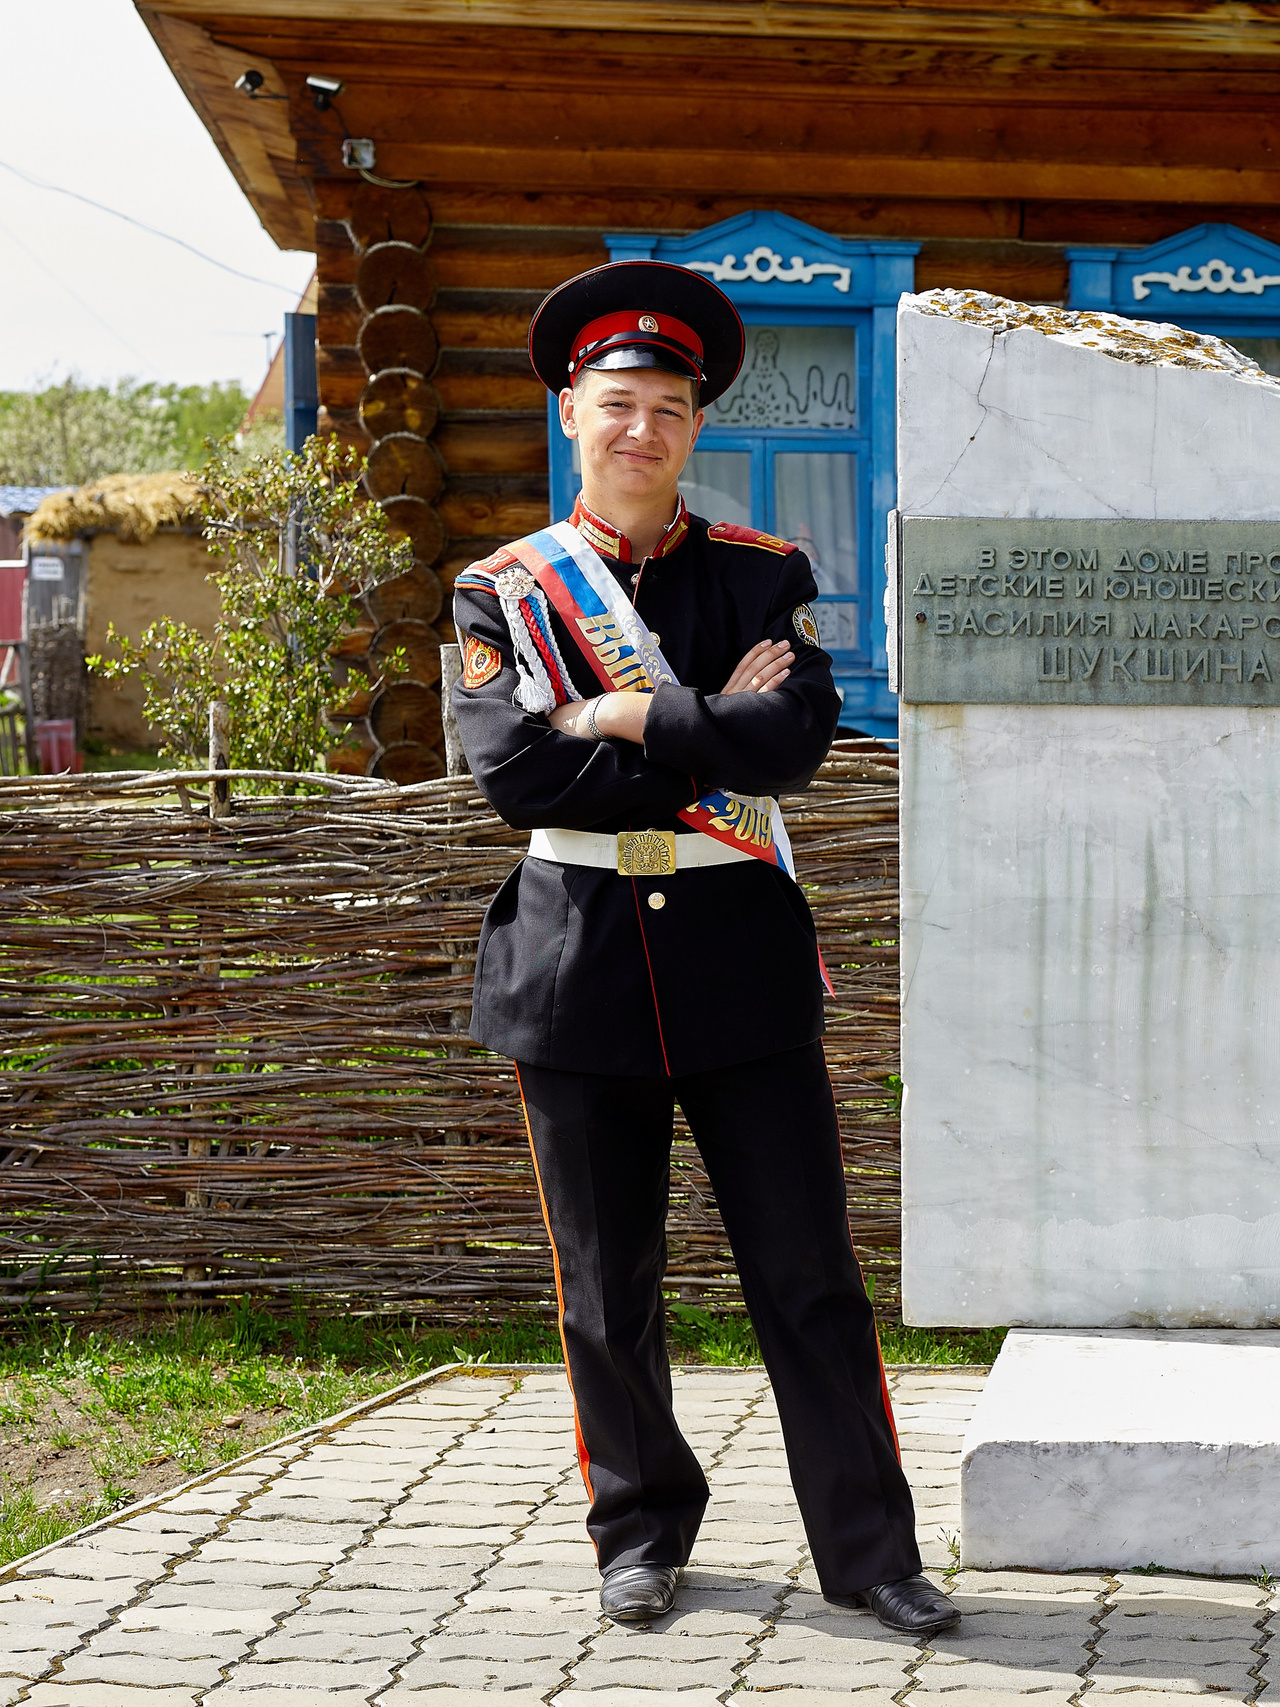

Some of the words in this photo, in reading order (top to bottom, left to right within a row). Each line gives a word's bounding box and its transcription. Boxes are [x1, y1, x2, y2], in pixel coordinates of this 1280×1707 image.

[976, 547, 997, 570] В
[1008, 546, 1099, 571] ЭТОМ
[1112, 549, 1208, 574] ДОМЕ
[913, 573, 1064, 598] ДЕТСКИЕ
[1075, 576, 1094, 599] И
[934, 610, 1111, 637] ВАСИЛИЯ
[575, 613, 655, 693] ВЫП
[1037, 647, 1272, 684] ШУКШИНА
